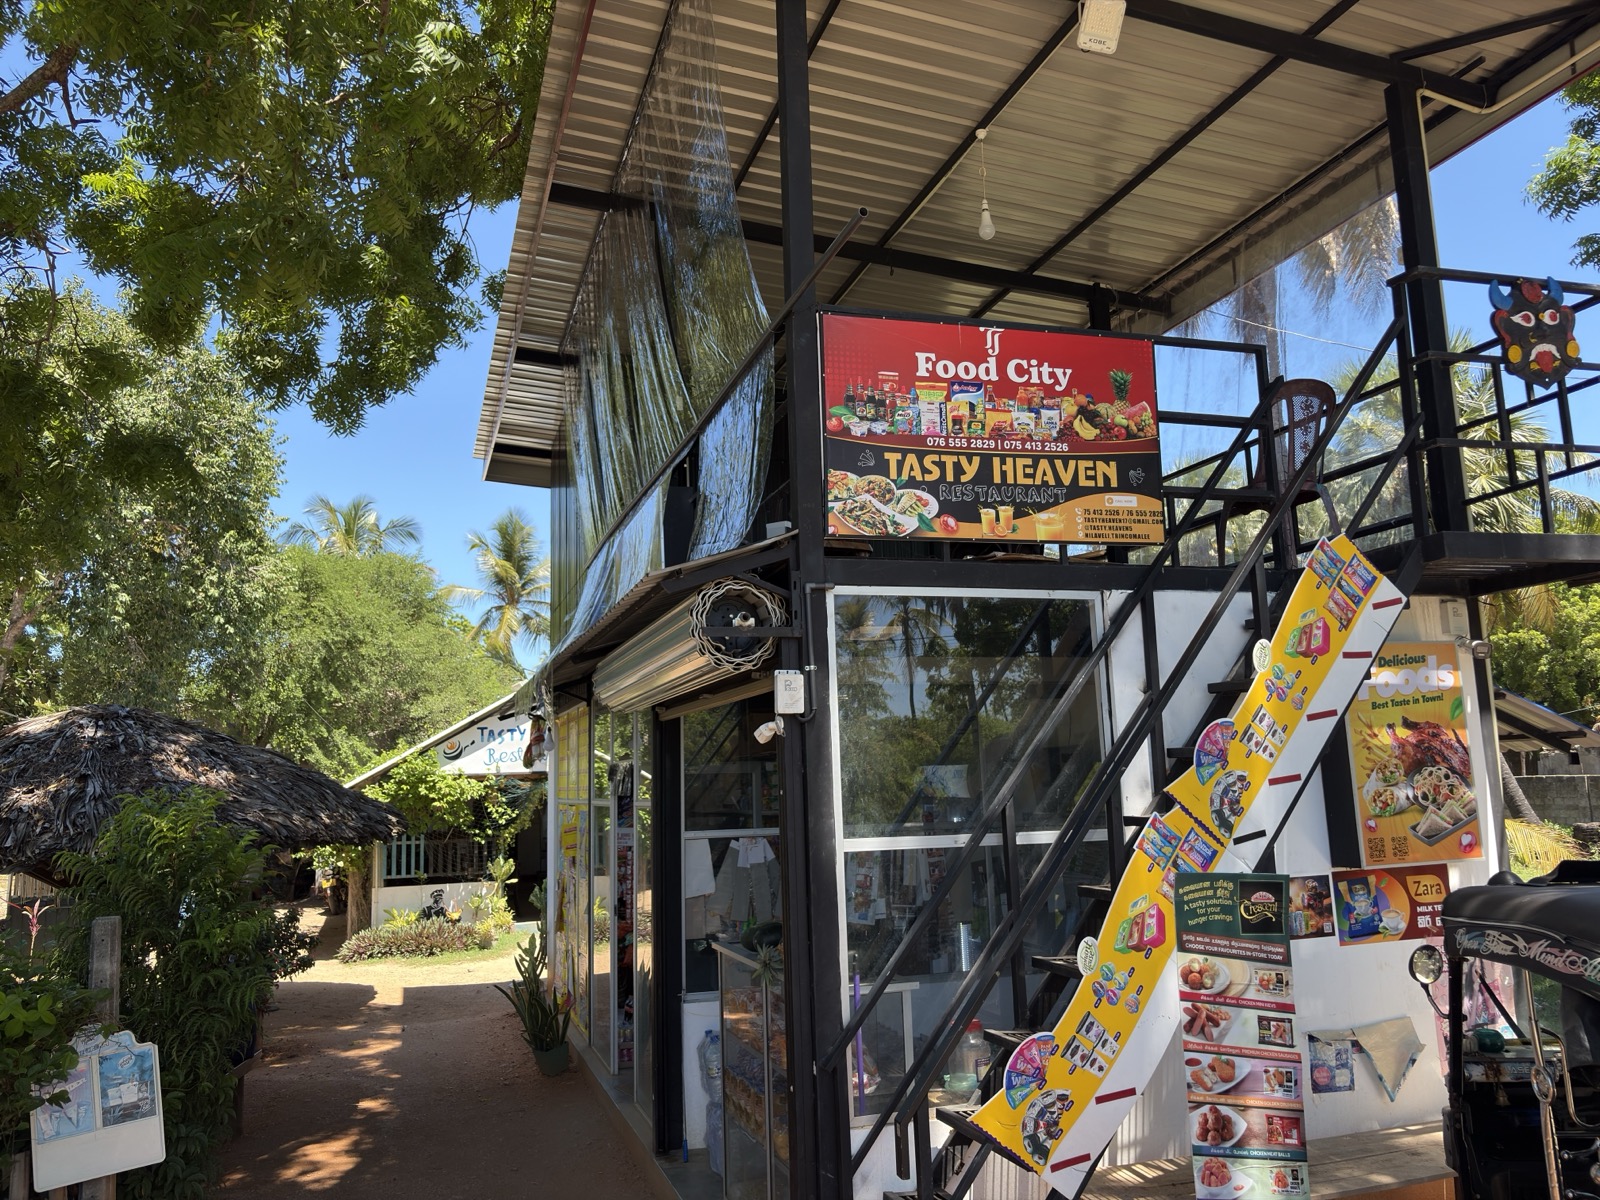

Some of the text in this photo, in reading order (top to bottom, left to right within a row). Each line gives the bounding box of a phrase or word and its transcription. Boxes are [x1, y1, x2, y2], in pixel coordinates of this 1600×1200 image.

[915, 352, 1072, 391] Food City
[926, 437, 945, 447] 076
[948, 438, 968, 448] 555
[970, 439, 996, 449] 2829
[1004, 440, 1022, 450] 075
[1025, 442, 1042, 451] 413
[1044, 442, 1069, 452] 2526
[884, 452, 1118, 488] TASTY HEAVEN
[939, 484, 1067, 503] RESTAURANT
[1378, 654, 1426, 668] Delicious
[1371, 693, 1444, 710] Best Taste in Town!
[477, 726, 526, 745] TASTY
[484, 748, 523, 766] Rest
[1413, 880, 1443, 897] Zara
[1190, 900, 1206, 910] tasty
[1206, 897, 1233, 906] solution
[1197, 906, 1221, 915] for your
[1416, 904, 1444, 913] MILK TE
[1188, 914, 1233, 926] hunger cravings
[1454, 928, 1479, 955] Open
[1218, 946, 1246, 956] FAVOURITES
[1246, 950, 1267, 958] IN-STORE
